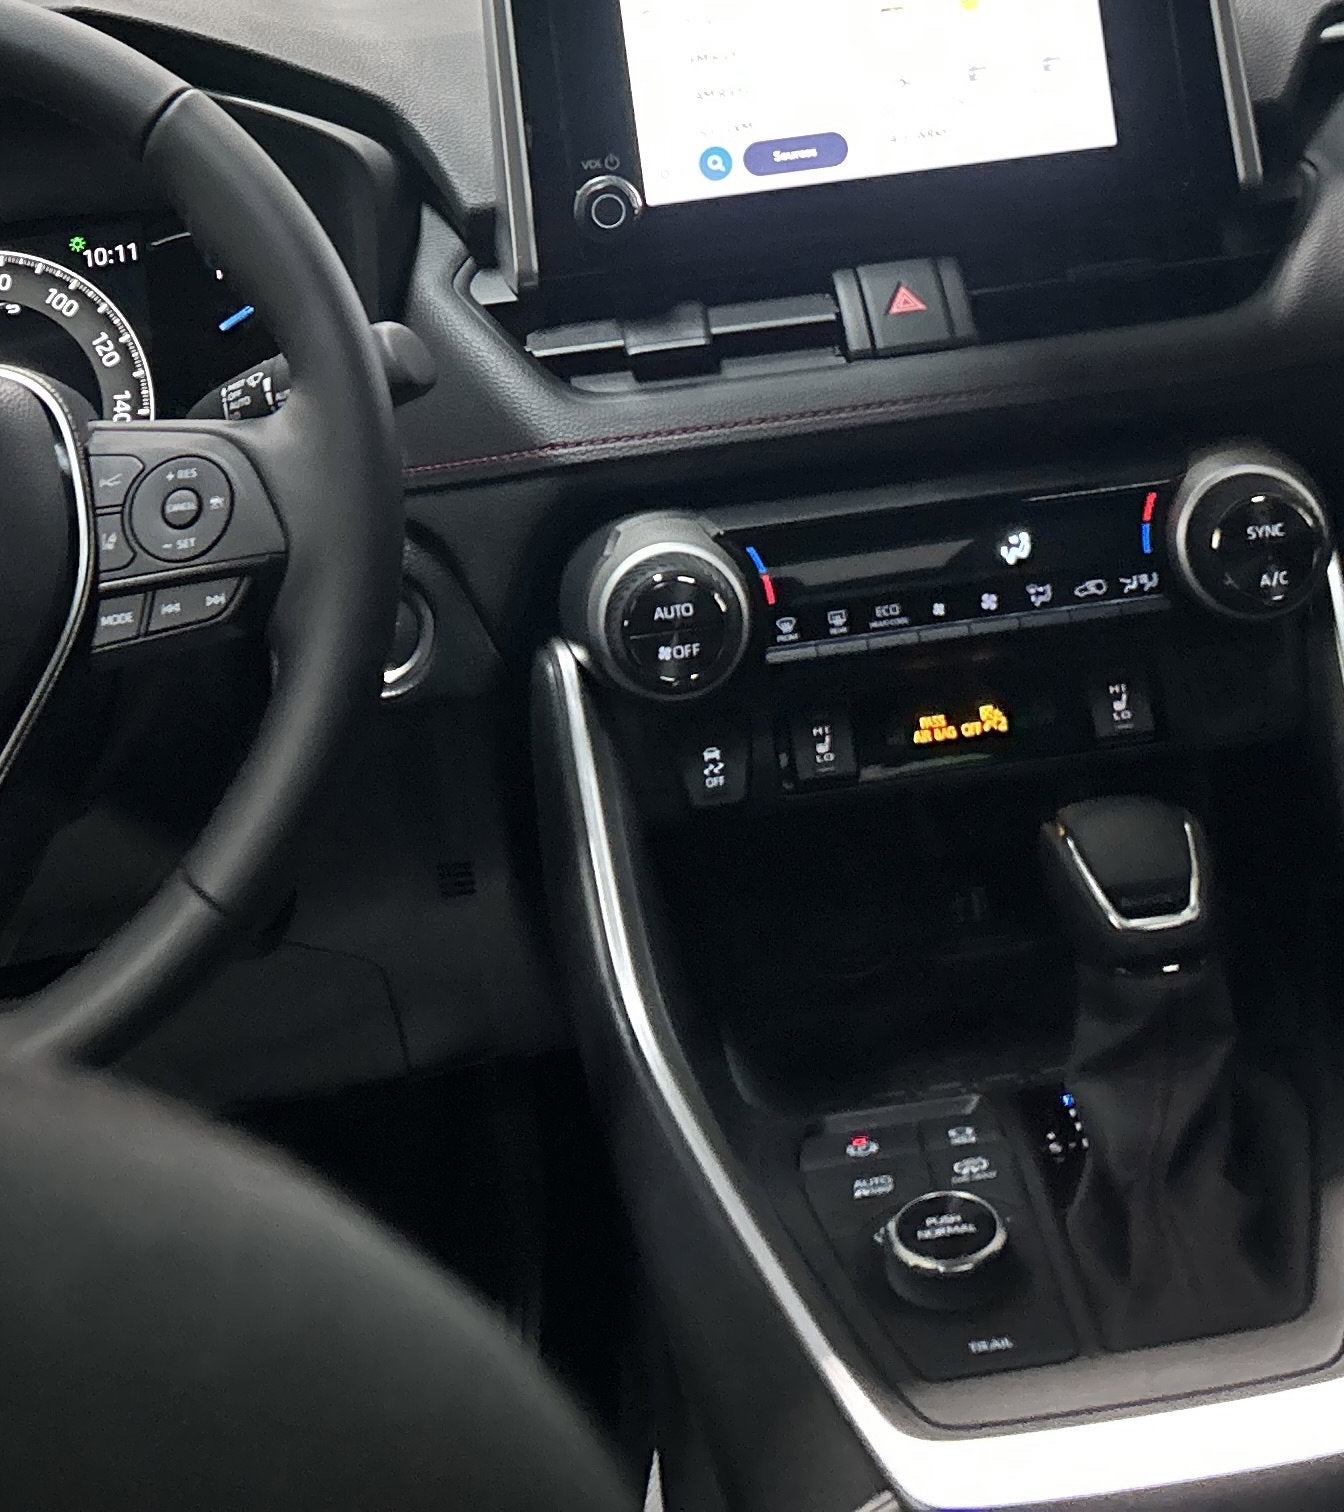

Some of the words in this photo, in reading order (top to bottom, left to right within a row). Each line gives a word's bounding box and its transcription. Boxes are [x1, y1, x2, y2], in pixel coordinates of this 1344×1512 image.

[772, 145, 818, 164] Sources
[83, 241, 139, 269] 10:11
[45, 287, 80, 319] 100
[90, 330, 121, 369] 120
[1246, 522, 1286, 540] SYNC
[1259, 570, 1290, 589] A/C
[99, 610, 135, 627] MODE
[653, 603, 694, 621] AUTO
[874, 603, 901, 618] ECO
[672, 643, 701, 659] OFF
[705, 776, 725, 789] OFF
[967, 1335, 1014, 1355] TRAIL
